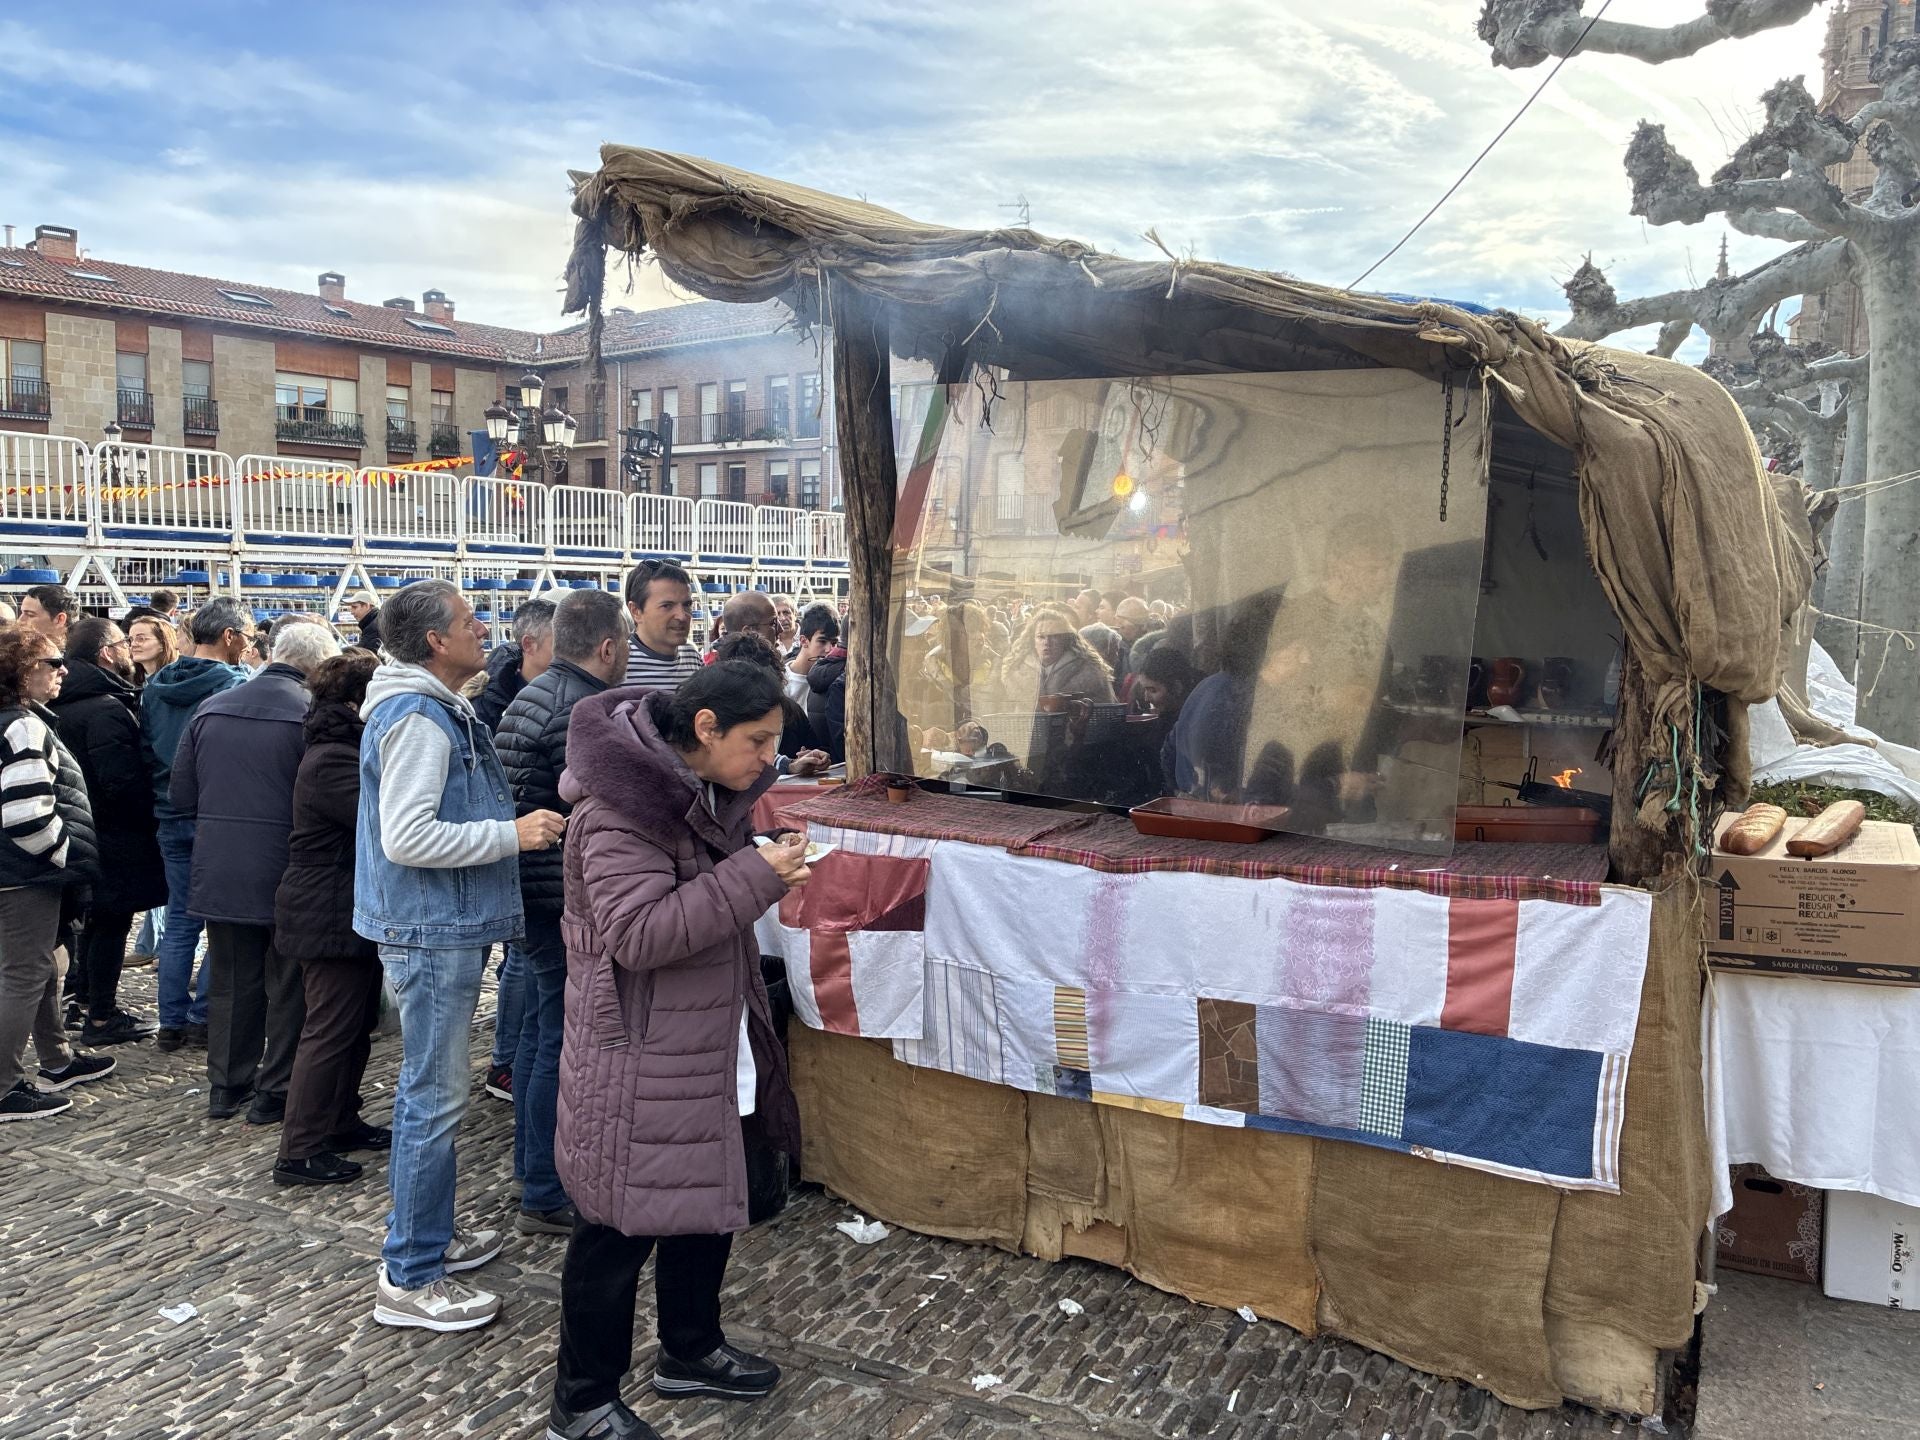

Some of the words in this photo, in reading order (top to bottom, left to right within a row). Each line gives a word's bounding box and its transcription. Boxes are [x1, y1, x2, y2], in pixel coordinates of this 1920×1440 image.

[1798, 893, 1836, 902] REDUCIR
[1798, 901, 1832, 911] REUSAR
[1798, 910, 1839, 920] RECICLAR
[1771, 960, 1800, 970] SABOR
[1801, 962, 1838, 972] INTENSO
